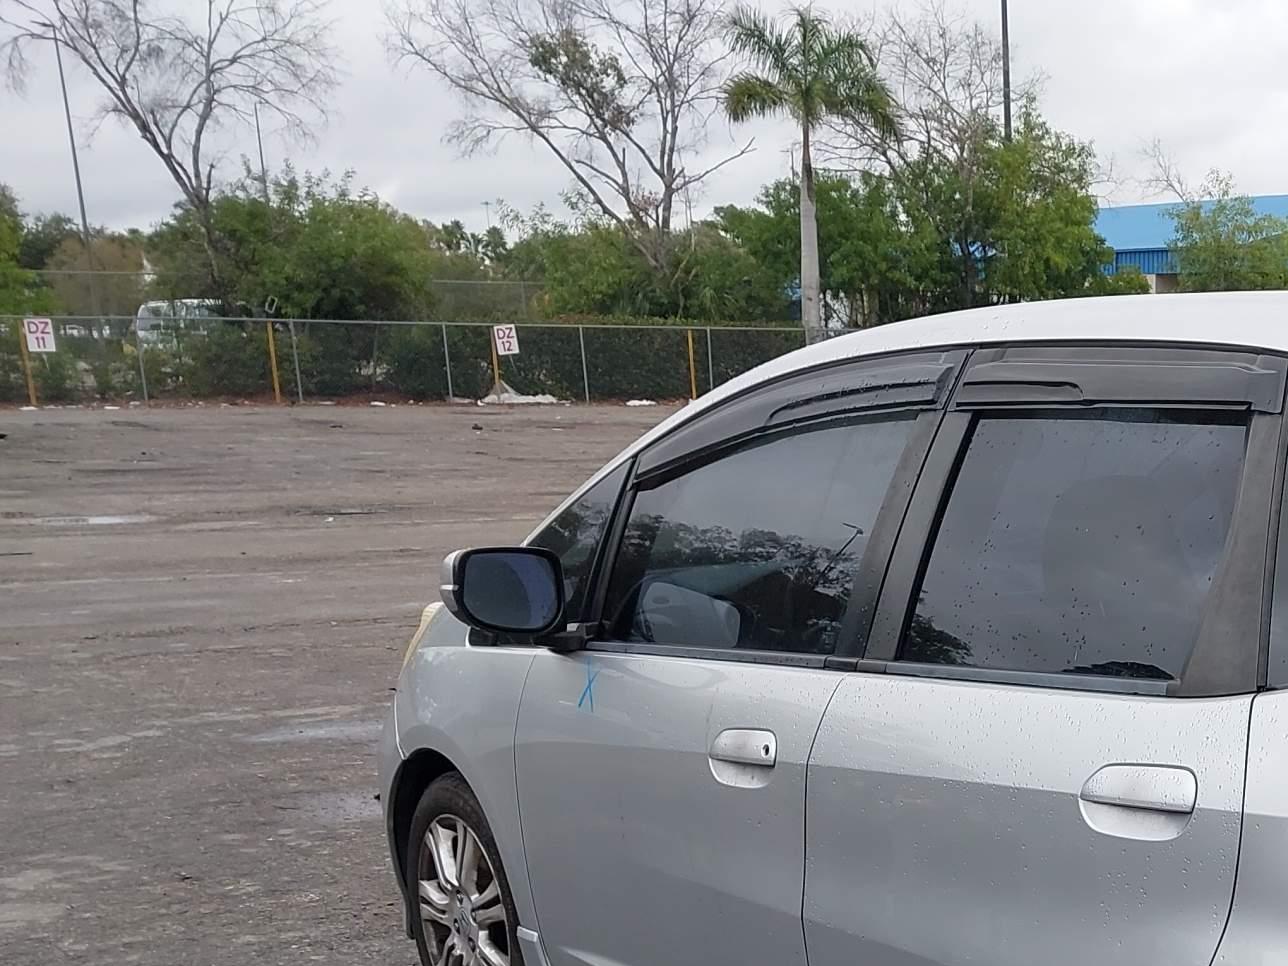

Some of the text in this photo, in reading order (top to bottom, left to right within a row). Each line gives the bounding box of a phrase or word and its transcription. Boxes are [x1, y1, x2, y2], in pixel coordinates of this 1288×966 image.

[27, 321, 50, 334] DZ
[496, 327, 515, 340] DZ
[35, 336, 46, 349] 11
[501, 341, 513, 352] 12
